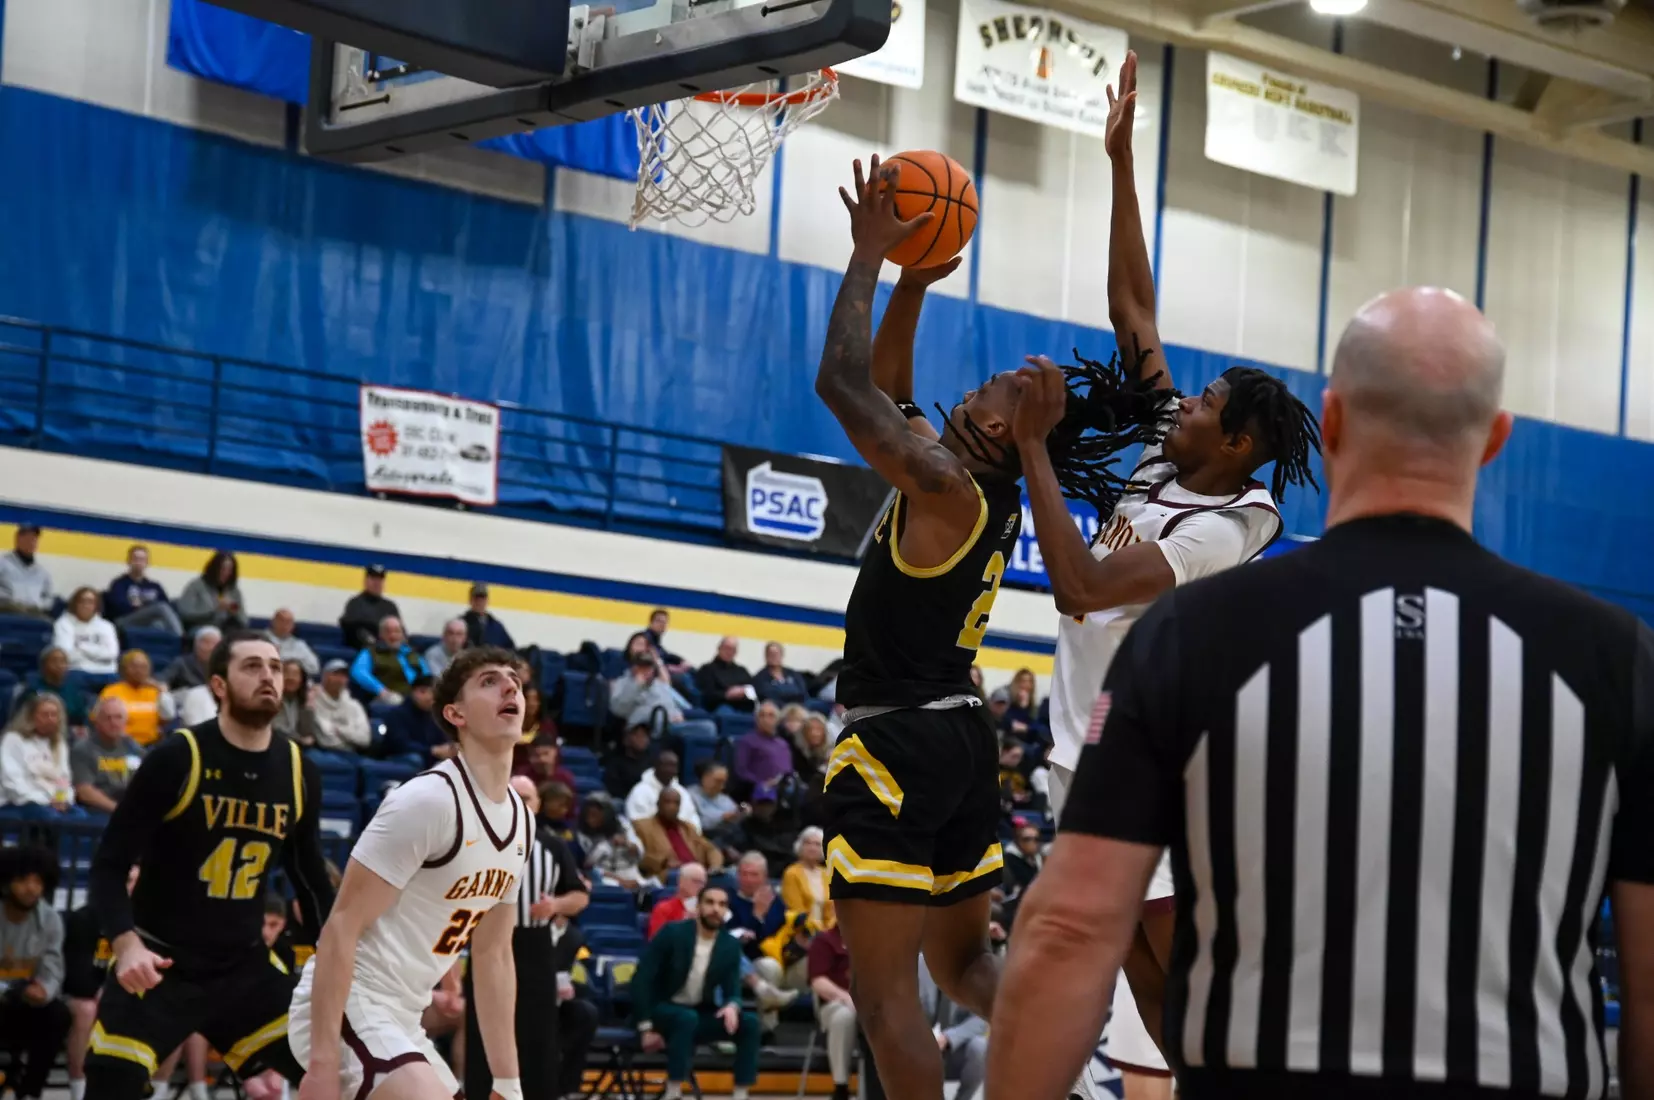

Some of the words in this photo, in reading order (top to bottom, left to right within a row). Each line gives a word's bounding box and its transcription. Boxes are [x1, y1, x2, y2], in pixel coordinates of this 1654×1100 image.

[751, 488, 820, 521] PSAC
[956, 551, 1005, 650] 2
[202, 794, 289, 840] VILLE
[199, 837, 272, 899] 42
